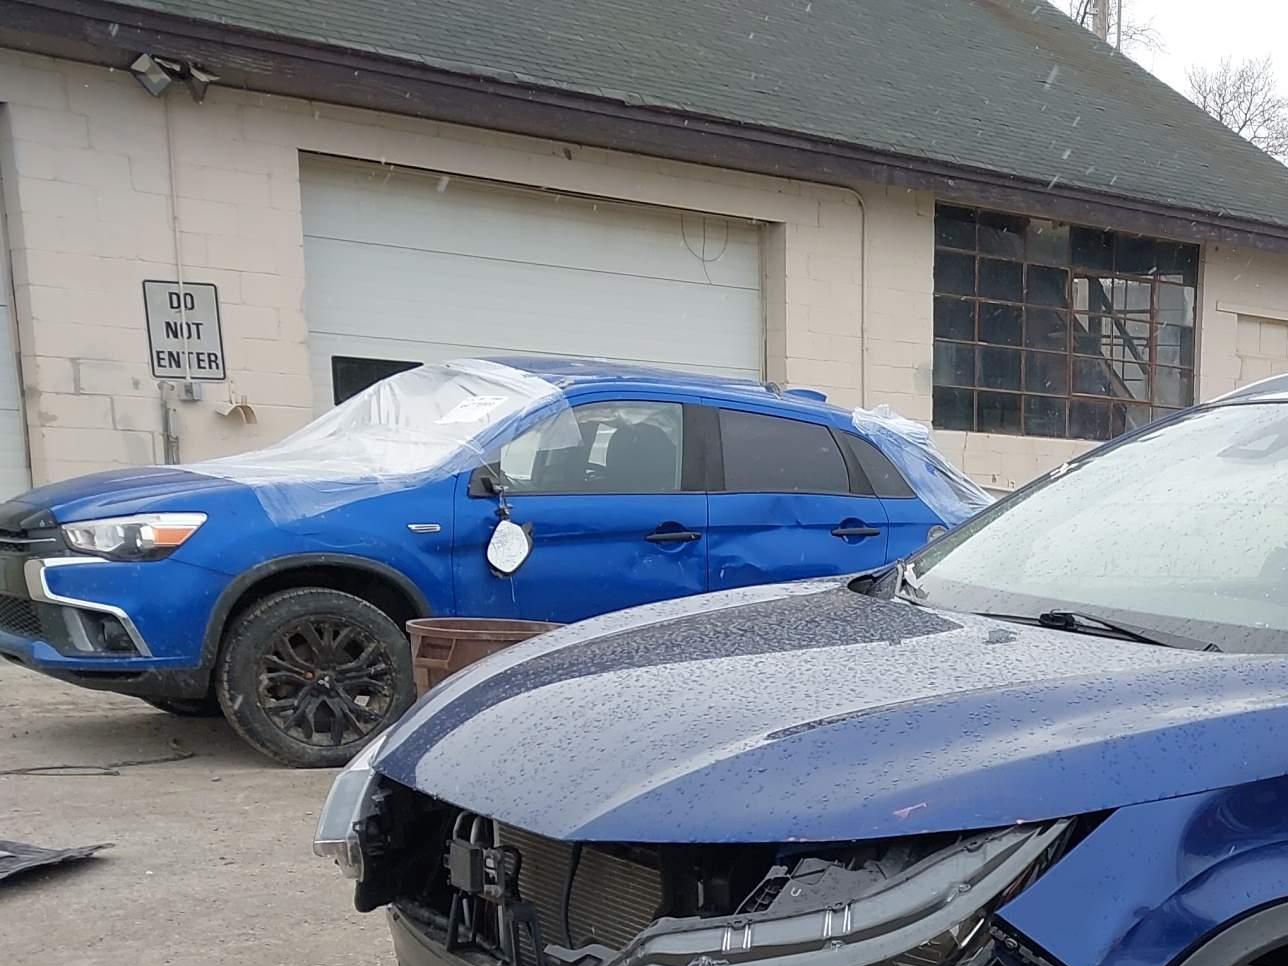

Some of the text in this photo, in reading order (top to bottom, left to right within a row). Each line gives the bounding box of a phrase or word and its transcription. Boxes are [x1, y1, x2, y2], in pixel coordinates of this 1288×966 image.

[168, 292, 195, 311] DO
[164, 321, 203, 340] NOT
[156, 350, 219, 370] ENTER
